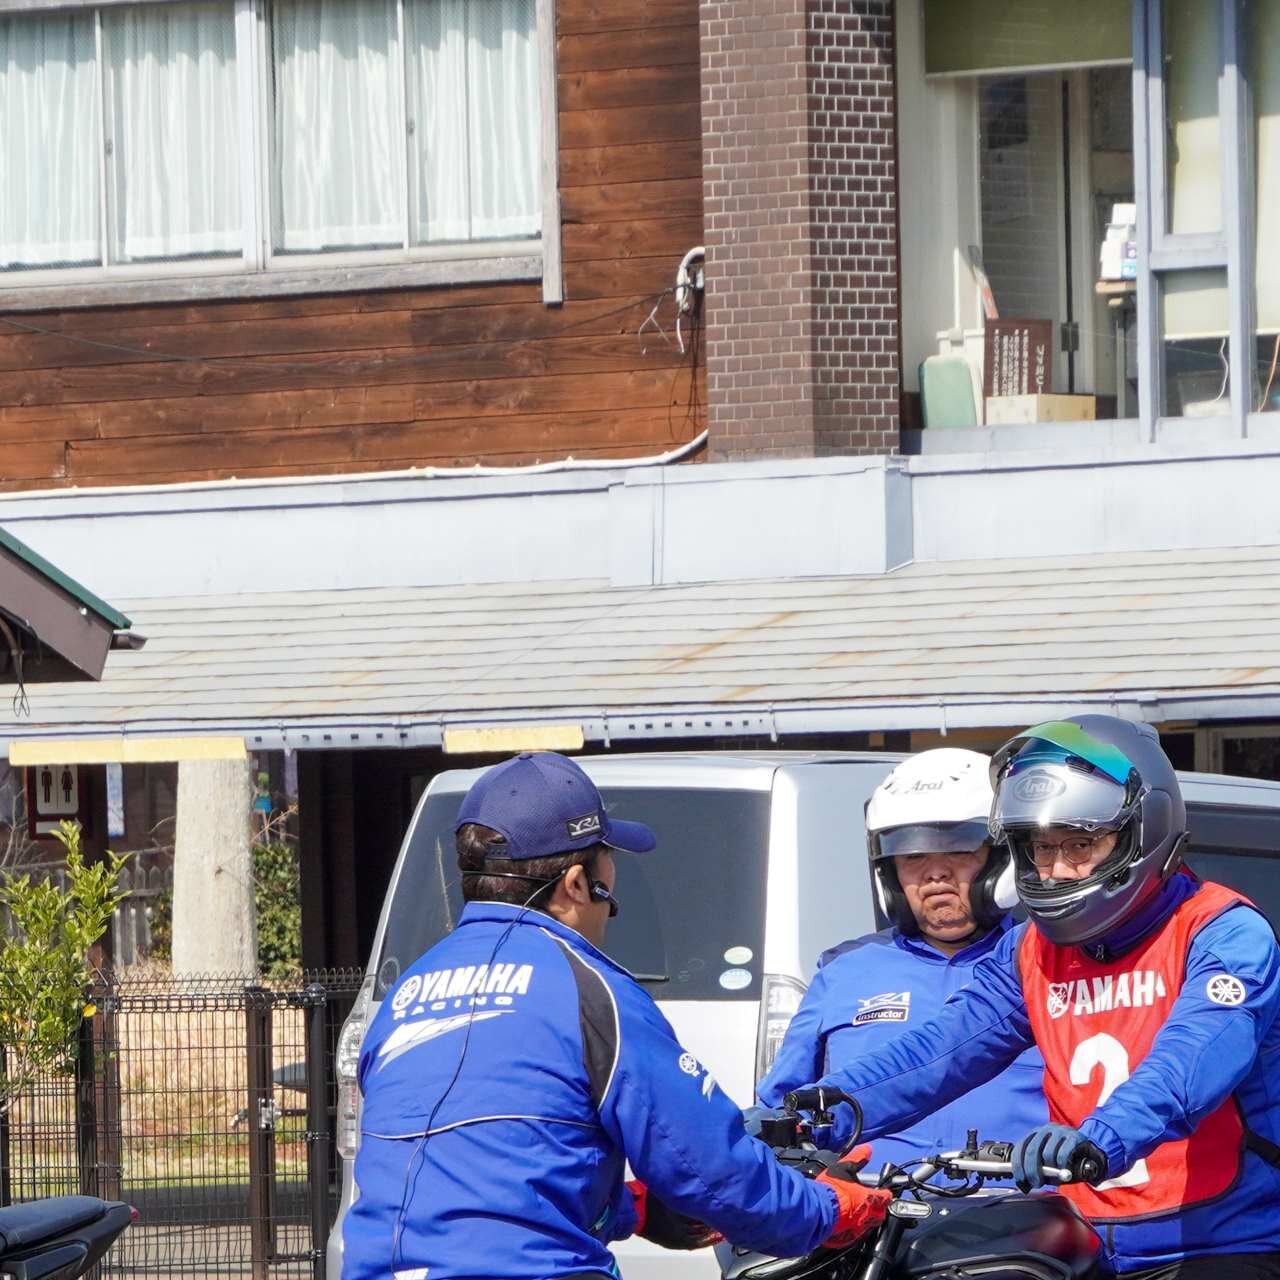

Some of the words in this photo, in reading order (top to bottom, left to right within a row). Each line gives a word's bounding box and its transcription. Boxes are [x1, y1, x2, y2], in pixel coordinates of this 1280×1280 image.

[912, 780, 943, 792] Arai
[418, 963, 534, 1003] YAMAHA
[393, 996, 513, 1021] RACING
[858, 1010, 904, 1021] instructor
